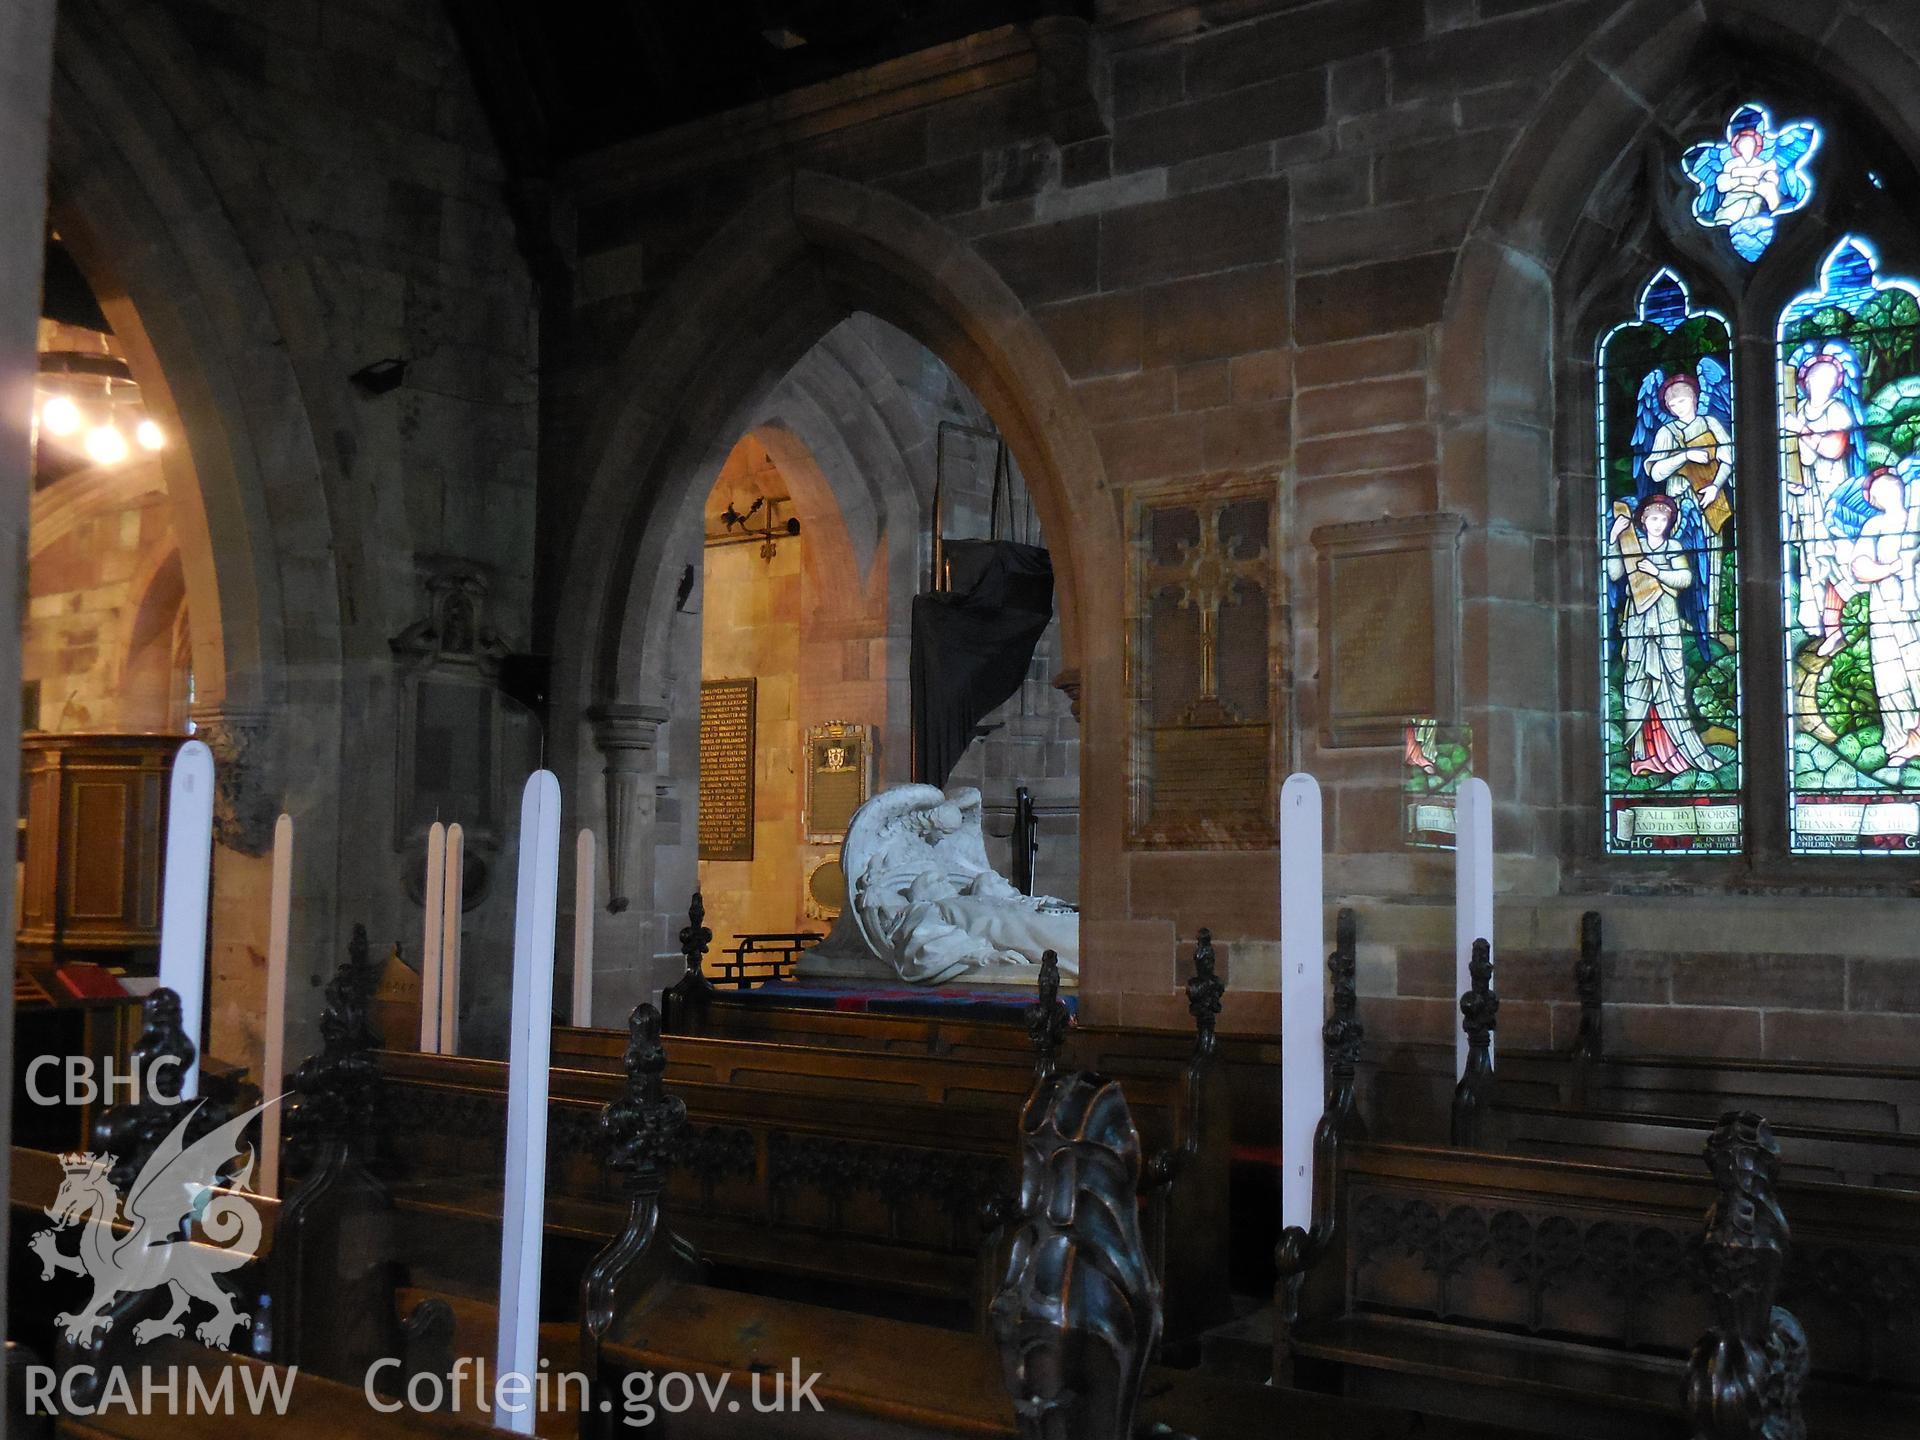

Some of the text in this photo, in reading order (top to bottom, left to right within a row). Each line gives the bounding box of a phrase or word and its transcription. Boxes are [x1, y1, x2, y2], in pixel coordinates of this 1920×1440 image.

[1645, 809, 1737, 820] ALL THY WORKS
[1635, 821, 1738, 831] AND THY SAINTS GIVE
